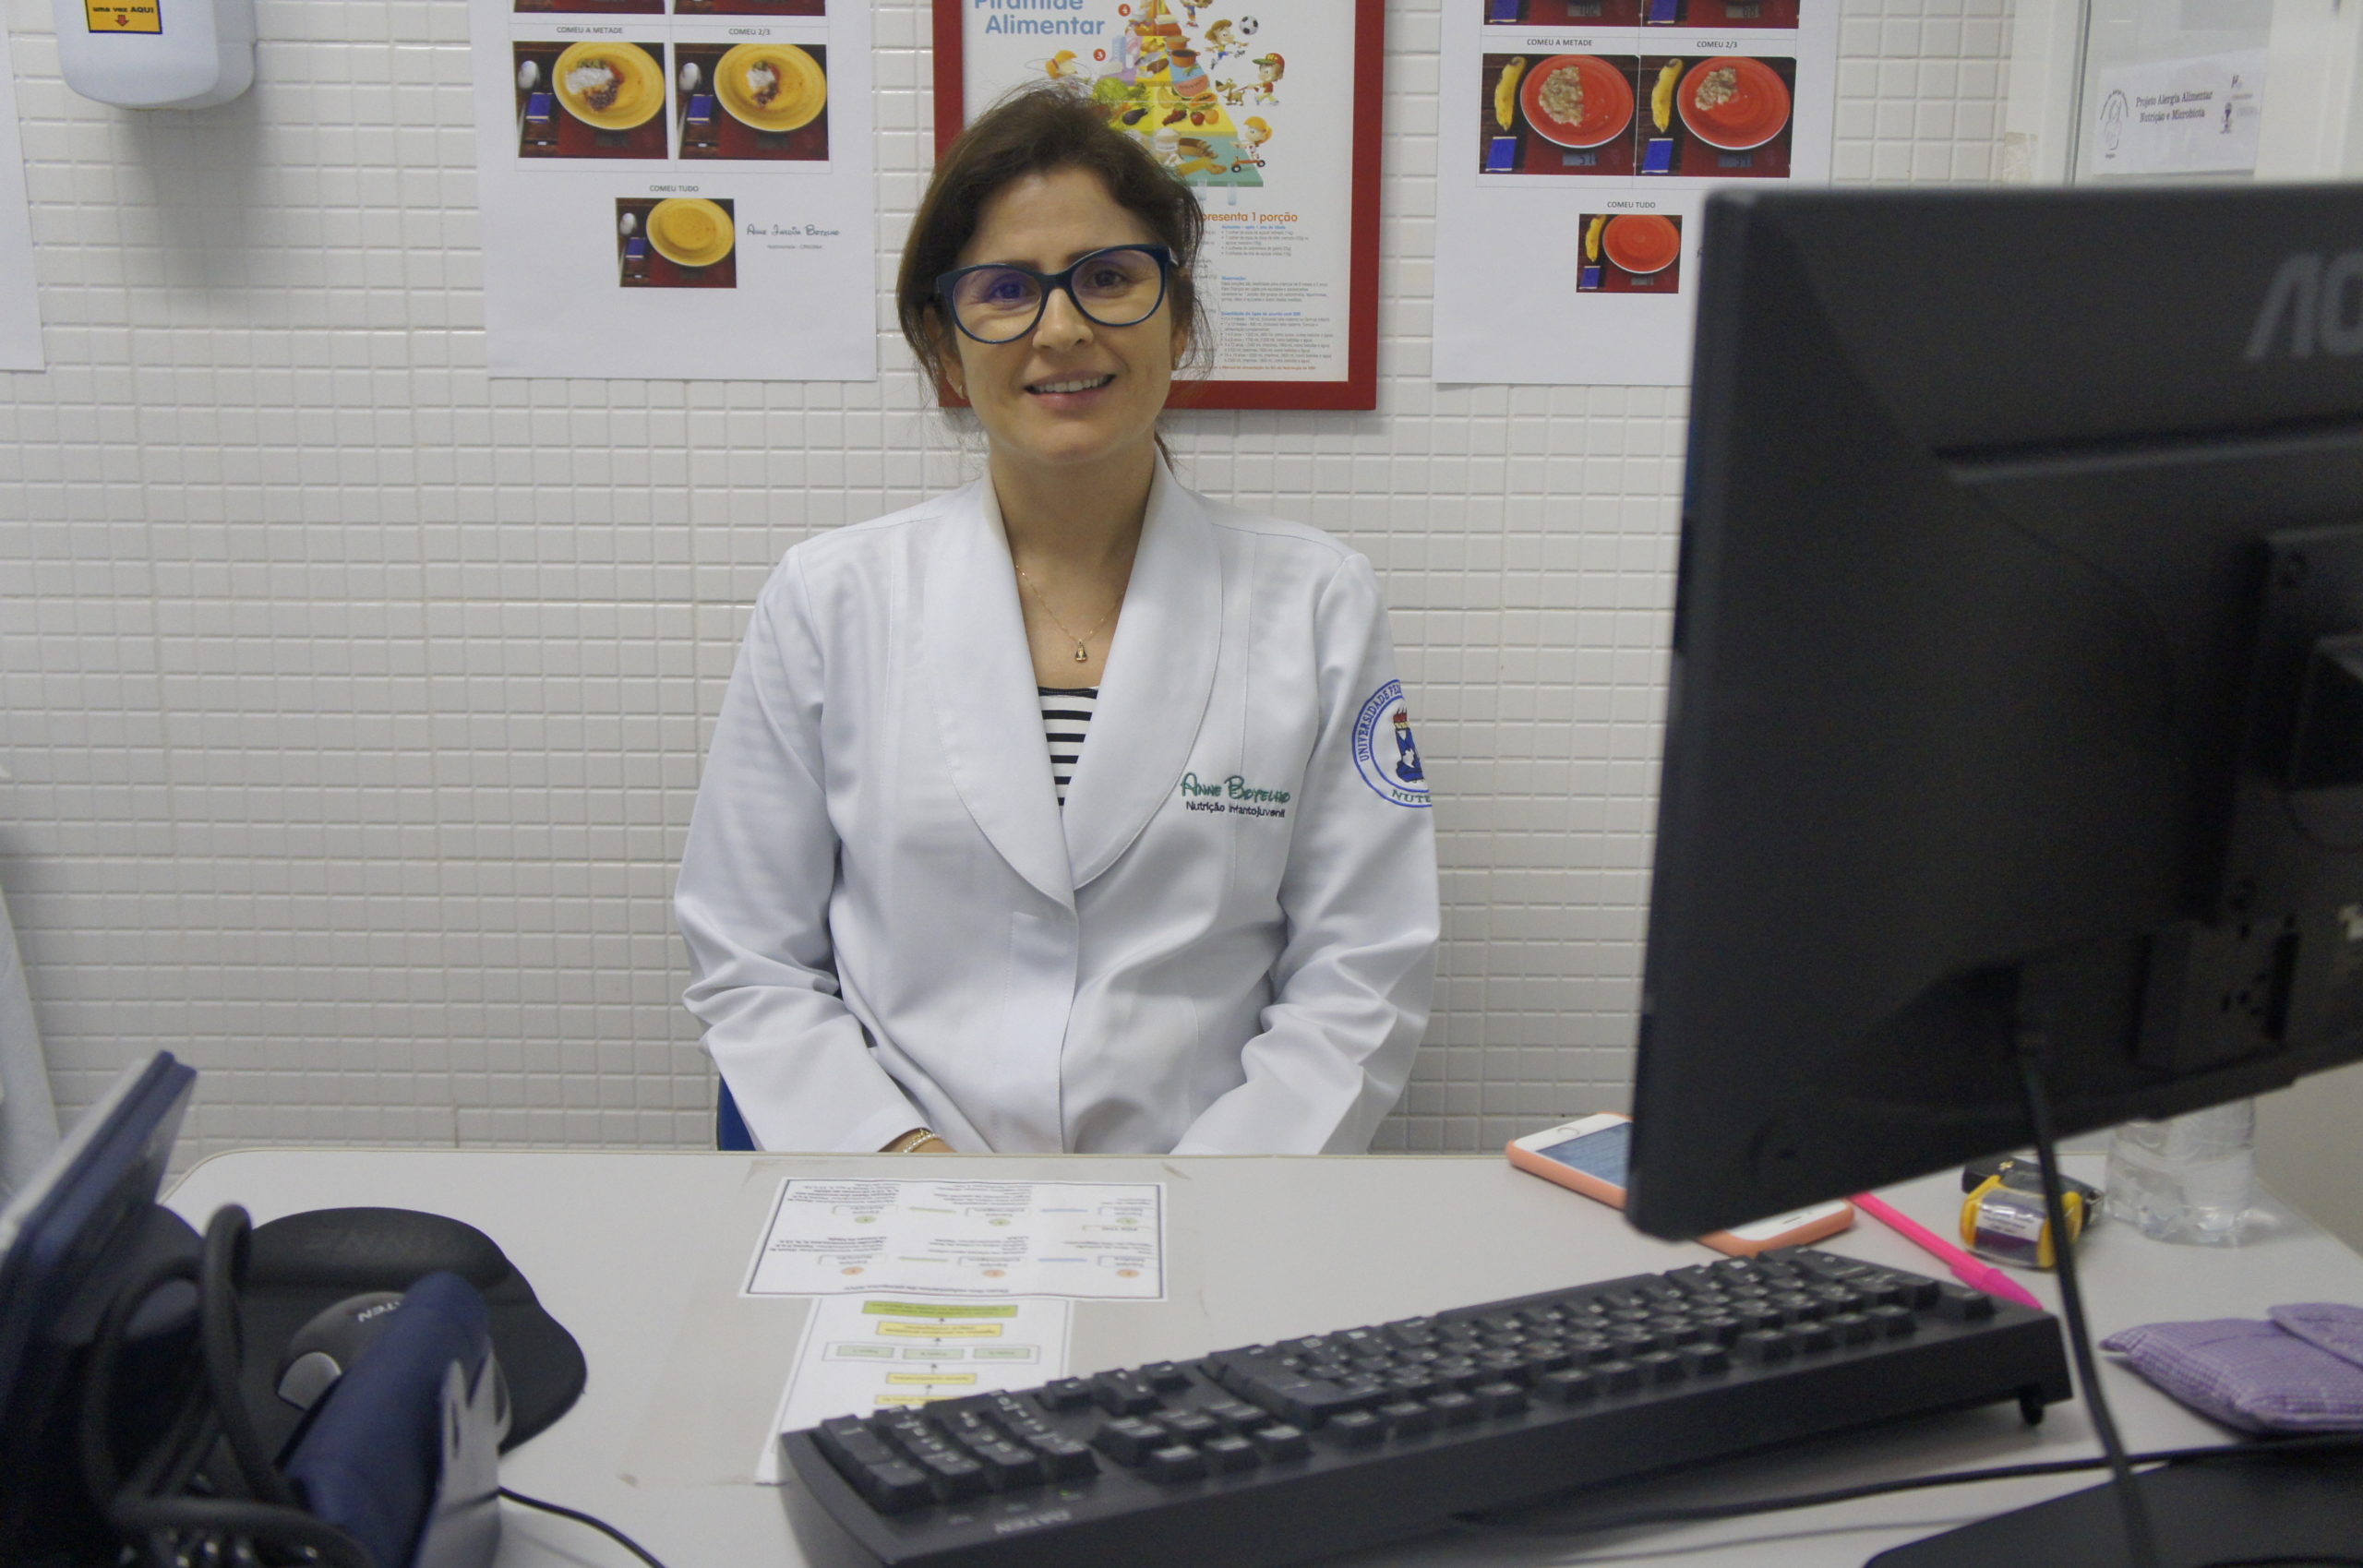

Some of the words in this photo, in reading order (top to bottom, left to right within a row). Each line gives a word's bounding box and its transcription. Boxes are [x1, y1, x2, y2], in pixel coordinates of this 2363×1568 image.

[557, 26, 583, 34] COMEU
[985, 14, 1105, 35] Alimentar
[1563, 39, 1592, 47] METADE
[1697, 41, 1723, 49] COMEU
[1725, 41, 1738, 49] 2/3
[2135, 96, 2156, 108] Projeto
[2157, 93, 2180, 106] Alergia
[2182, 90, 2213, 103] Alimentar
[2140, 112, 2165, 124] Nutrição
[2171, 108, 2205, 121] Microbiota
[649, 185, 677, 193] COMEU
[678, 185, 700, 193] TUDO
[1260, 211, 1298, 224] porção
[1357, 689, 1390, 762] UNIVERSIDADE
[1186, 801, 1225, 813] Nutrição
